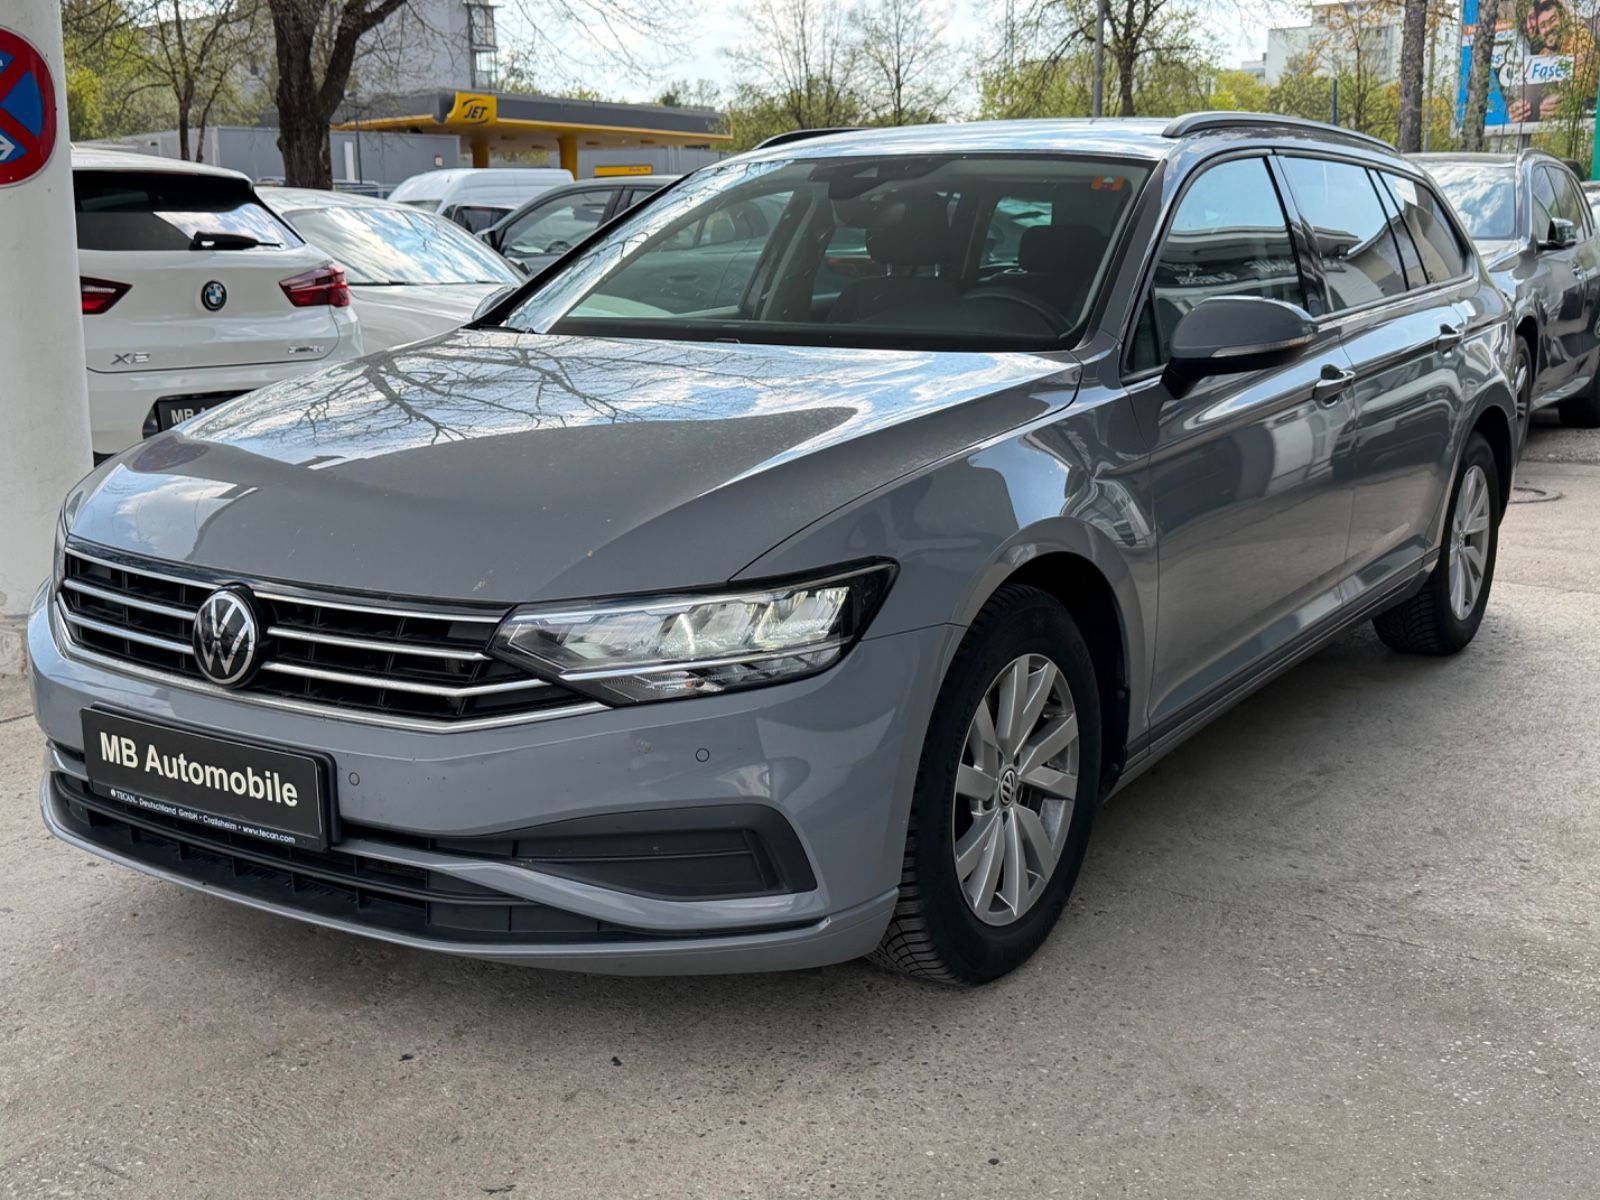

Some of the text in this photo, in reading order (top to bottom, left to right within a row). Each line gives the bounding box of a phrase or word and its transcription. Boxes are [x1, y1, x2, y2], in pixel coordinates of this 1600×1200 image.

[464, 104, 488, 119] JET
[100, 731, 299, 808] MB Automobile
[139, 798, 177, 815] Deutschland
[178, 808, 199, 821] GmbH
